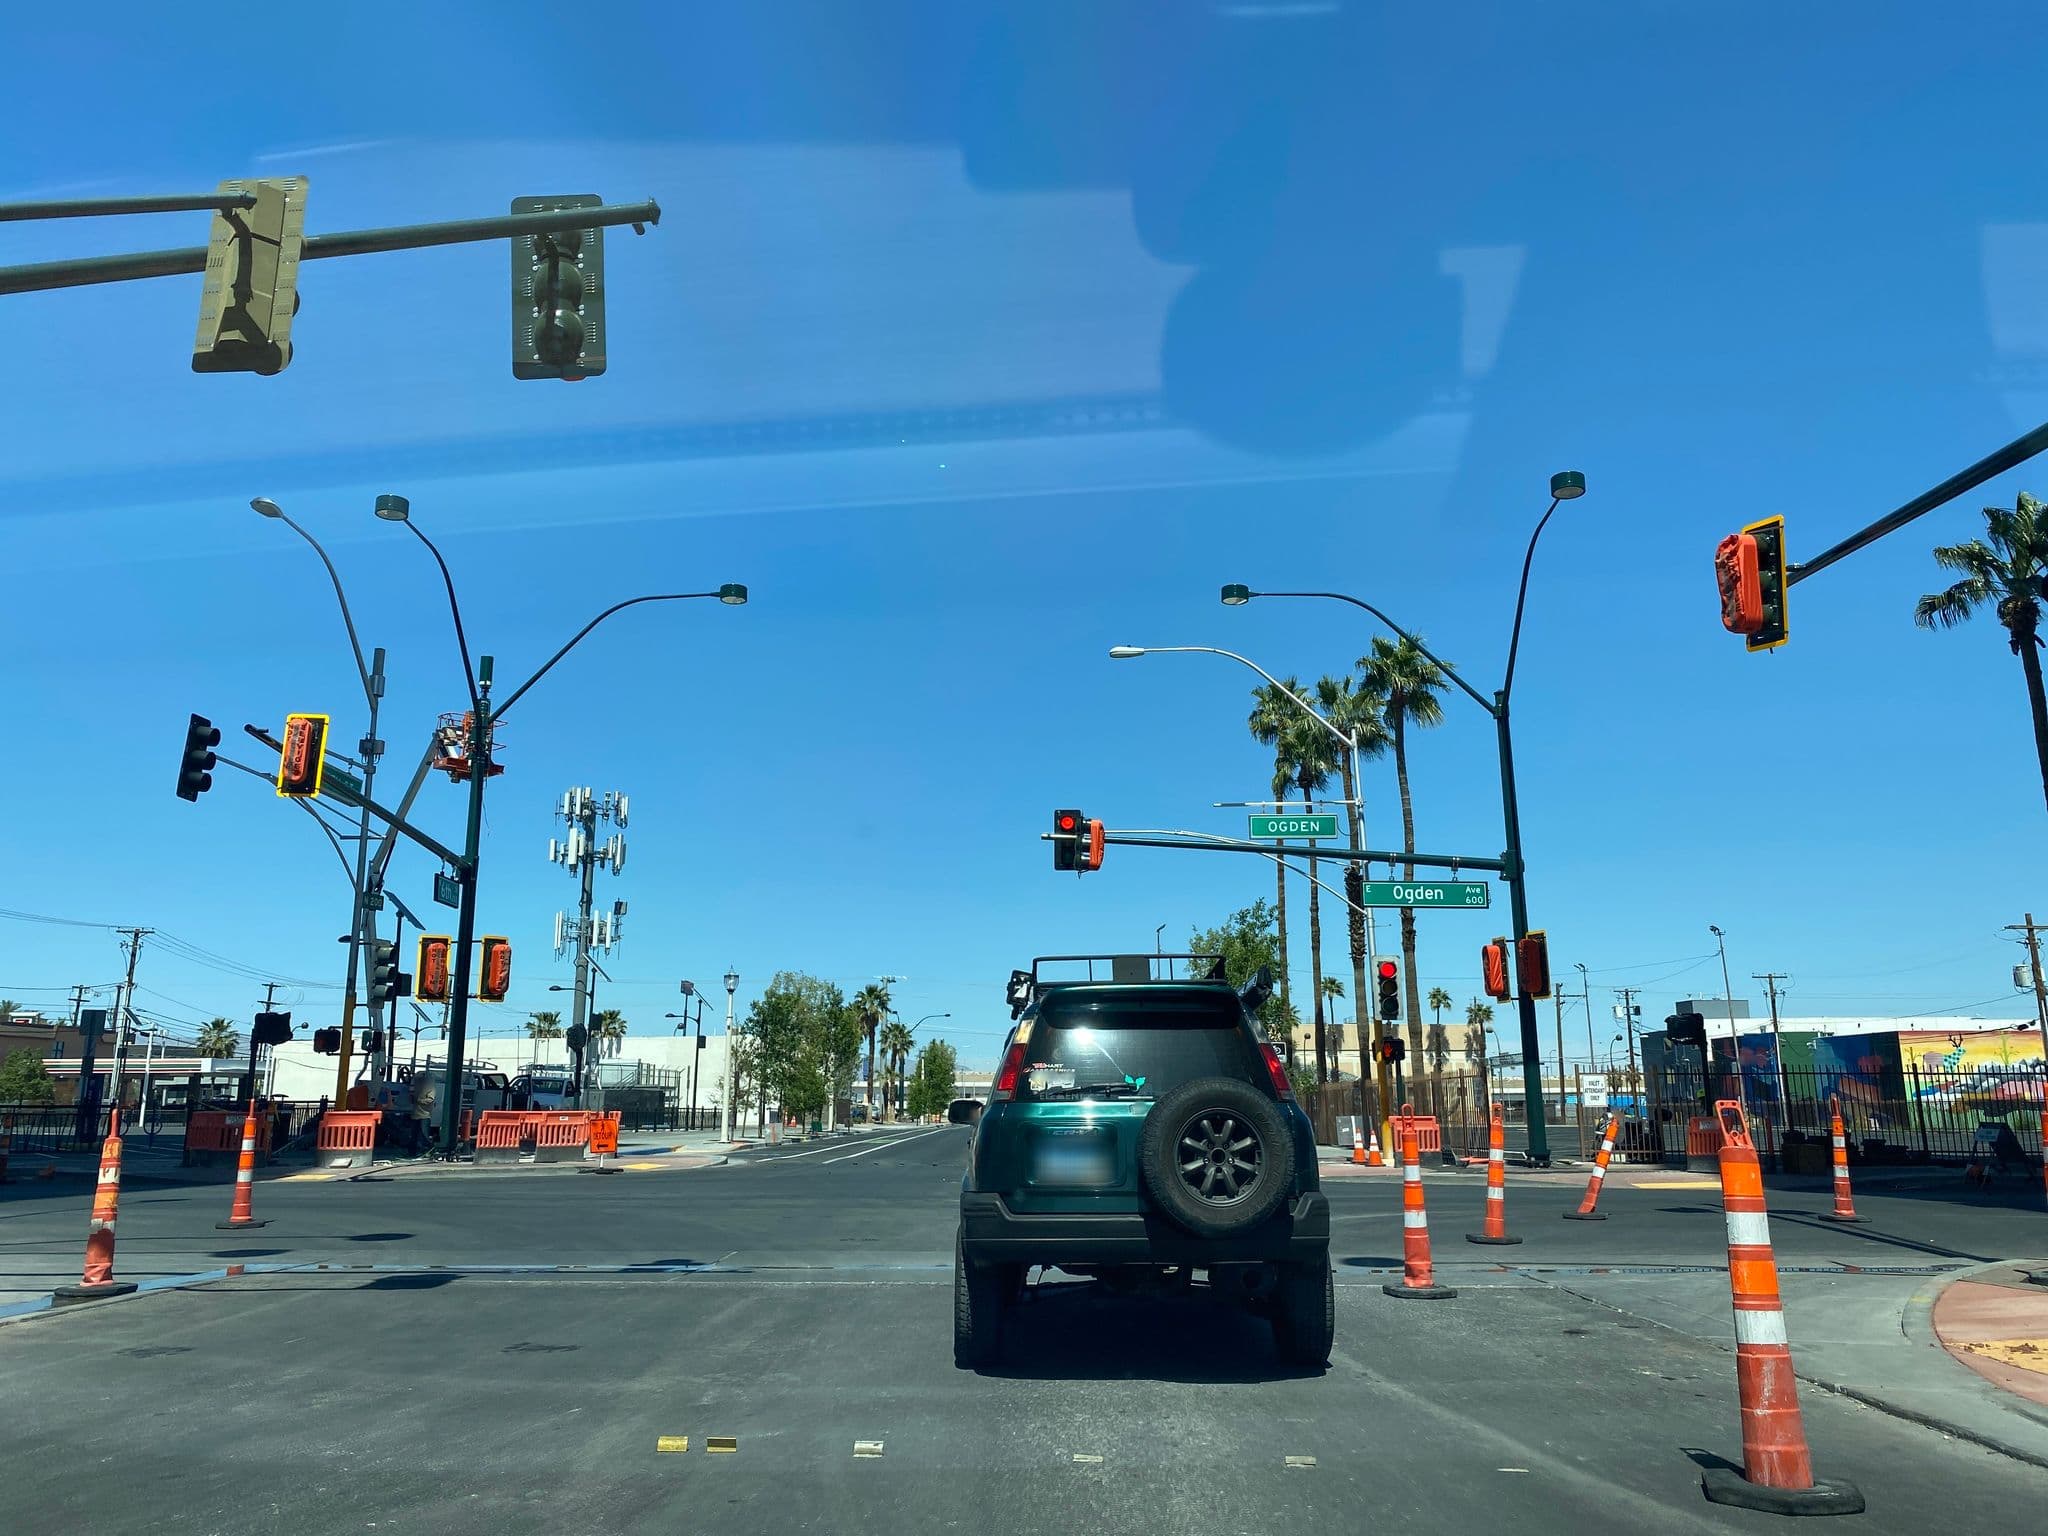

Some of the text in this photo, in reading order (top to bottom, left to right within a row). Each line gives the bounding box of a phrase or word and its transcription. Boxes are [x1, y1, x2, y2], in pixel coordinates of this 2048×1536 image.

[1268, 821, 1320, 832] OGDEN
[1366, 885, 1481, 903] E Ogden Ave
[1465, 896, 1484, 904] 600
